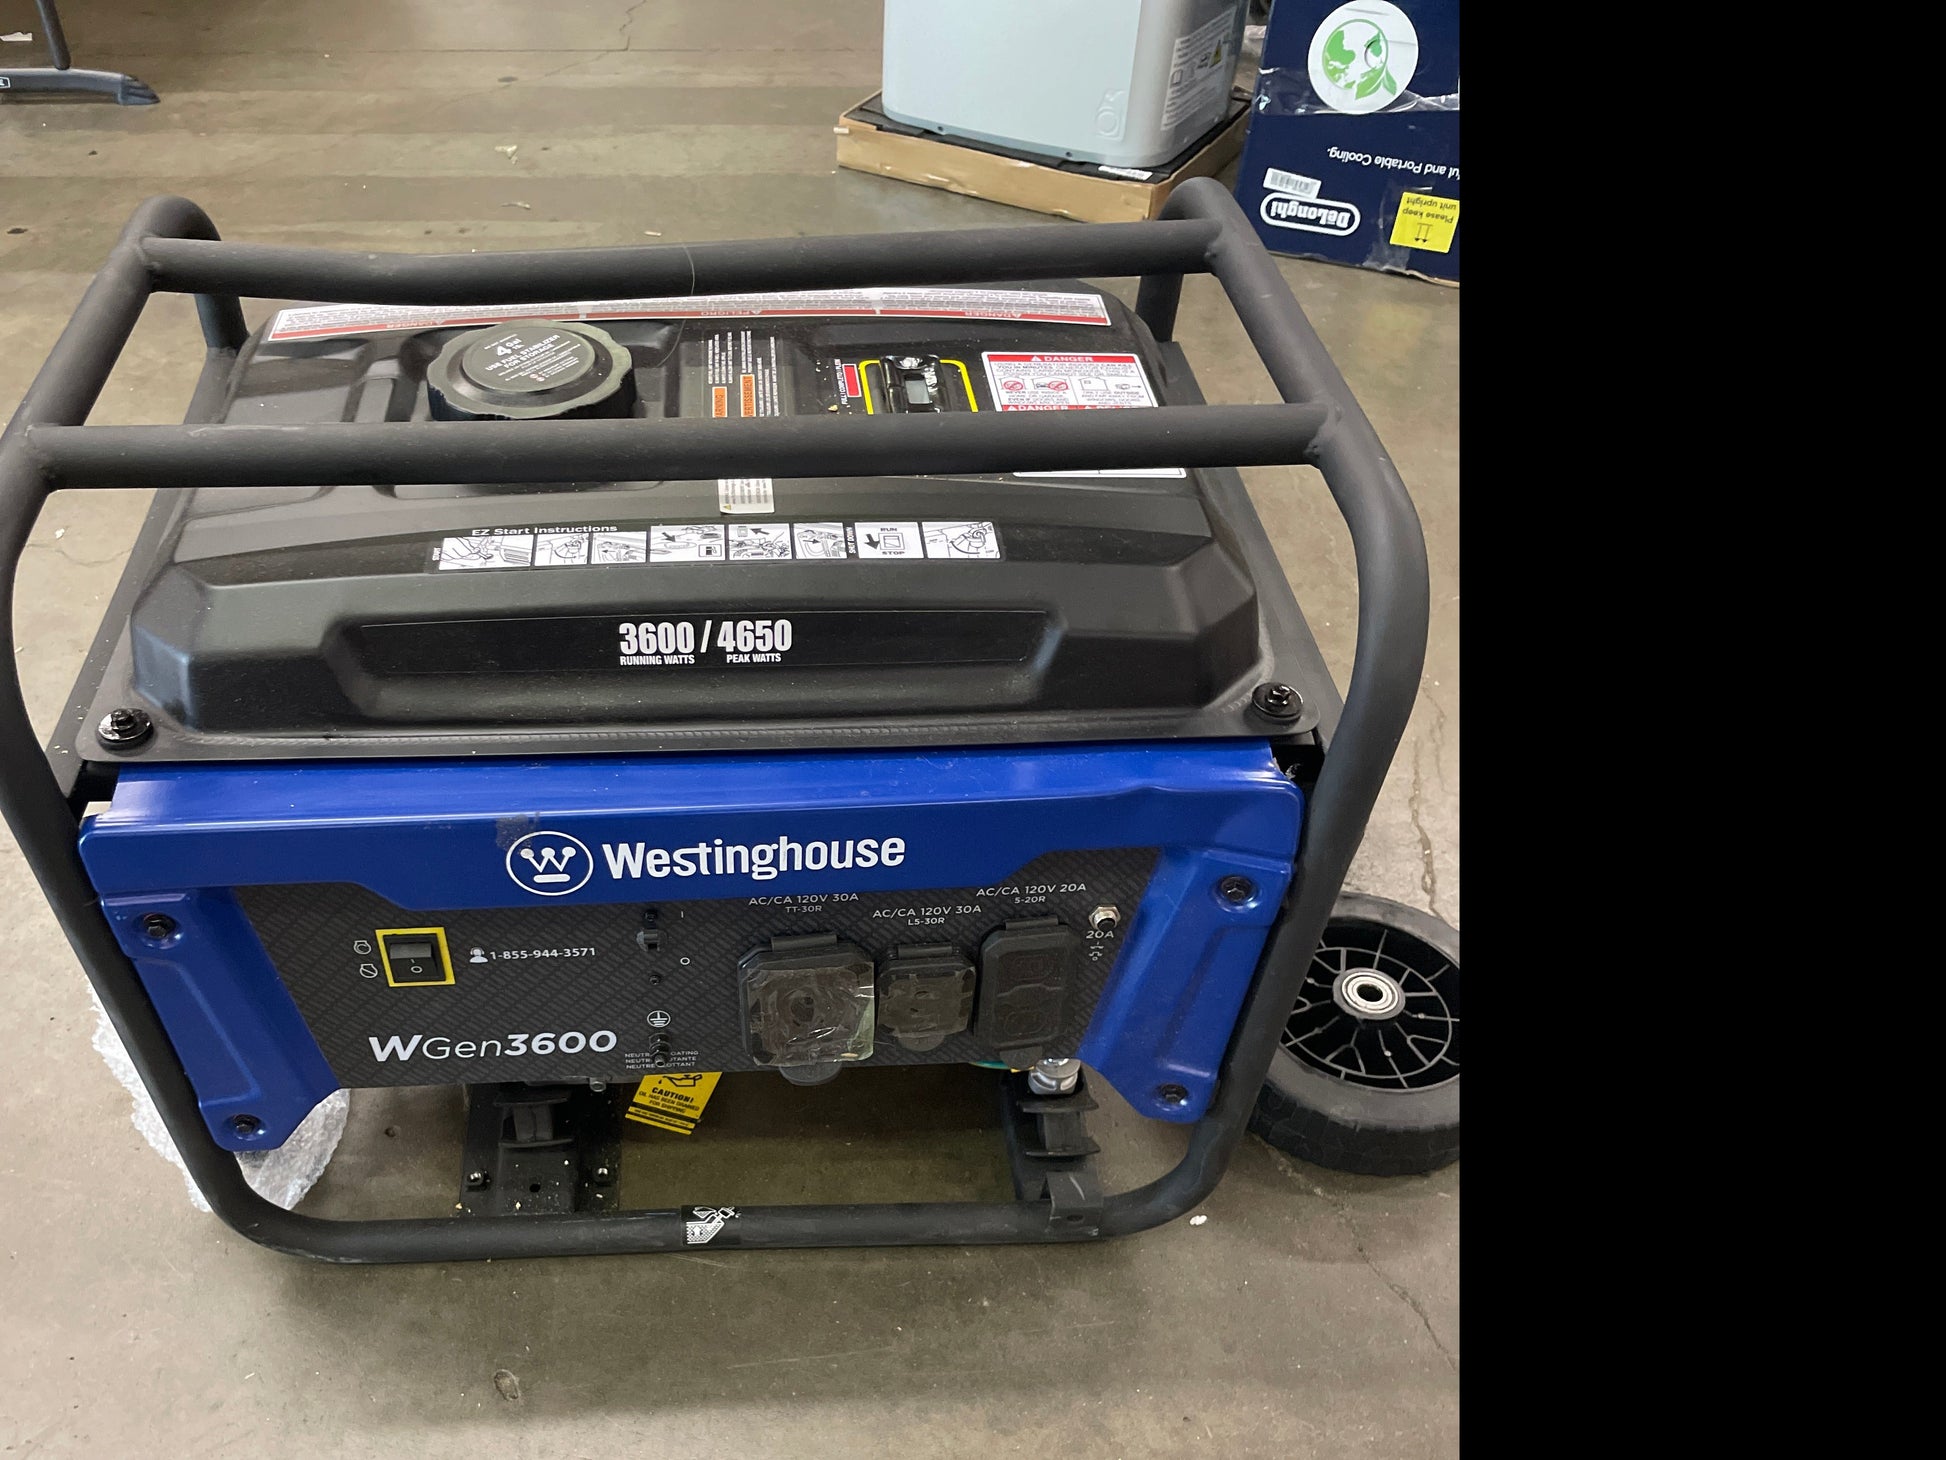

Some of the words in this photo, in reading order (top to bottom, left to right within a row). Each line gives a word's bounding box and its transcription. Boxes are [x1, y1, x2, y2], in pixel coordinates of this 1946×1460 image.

[1327, 146, 1372, 166] Cooling.
[1374, 155, 1423, 174] Portable
[1423, 163, 1446, 175] and
[1447, 167, 1459, 180] ul
[1406, 196, 1438, 208] upright
[1439, 201, 1457, 211] unit
[1402, 207, 1424, 219] keep
[1426, 211, 1454, 224] Please
[484, 361, 503, 371] USE
[501, 354, 521, 364] FUEL
[520, 334, 560, 355] STABILIZER
[497, 345, 512, 356] 4
[742, 376, 754, 416] ERTISSEMENT
[714, 394, 725, 416] ARNING
[494, 527, 530, 535] Start
[534, 525, 618, 535] Instructions
[618, 621, 695, 655] 3600
[717, 619, 793, 653] 4650
[619, 654, 662, 666] RUNNING
[664, 653, 695, 665] WATTS
[726, 653, 751, 663] PEAK
[752, 652, 782, 663] WATTS
[601, 835, 906, 881] Westinghouse
[976, 886, 1020, 897] AC/CA
[1025, 884, 1057, 894] 120V
[1059, 883, 1087, 893] 20A
[748, 895, 793, 906] AC/CA
[797, 894, 828, 904] 120V
[832, 892, 859, 902] 30A
[1014, 895, 1046, 904] 5-20R
[785, 905, 822, 913] TT-30R
[872, 908, 916, 919] AC/CA
[920, 906, 952, 916] 120V
[955, 904, 982, 914] 30A
[907, 916, 945, 926] L5-30R
[1086, 930, 1114, 939] 20A
[489, 947, 596, 961] 1-855-944-3571
[368, 1030, 618, 1063] WGen3600
[651, 1086, 694, 1103] CAUTION!
